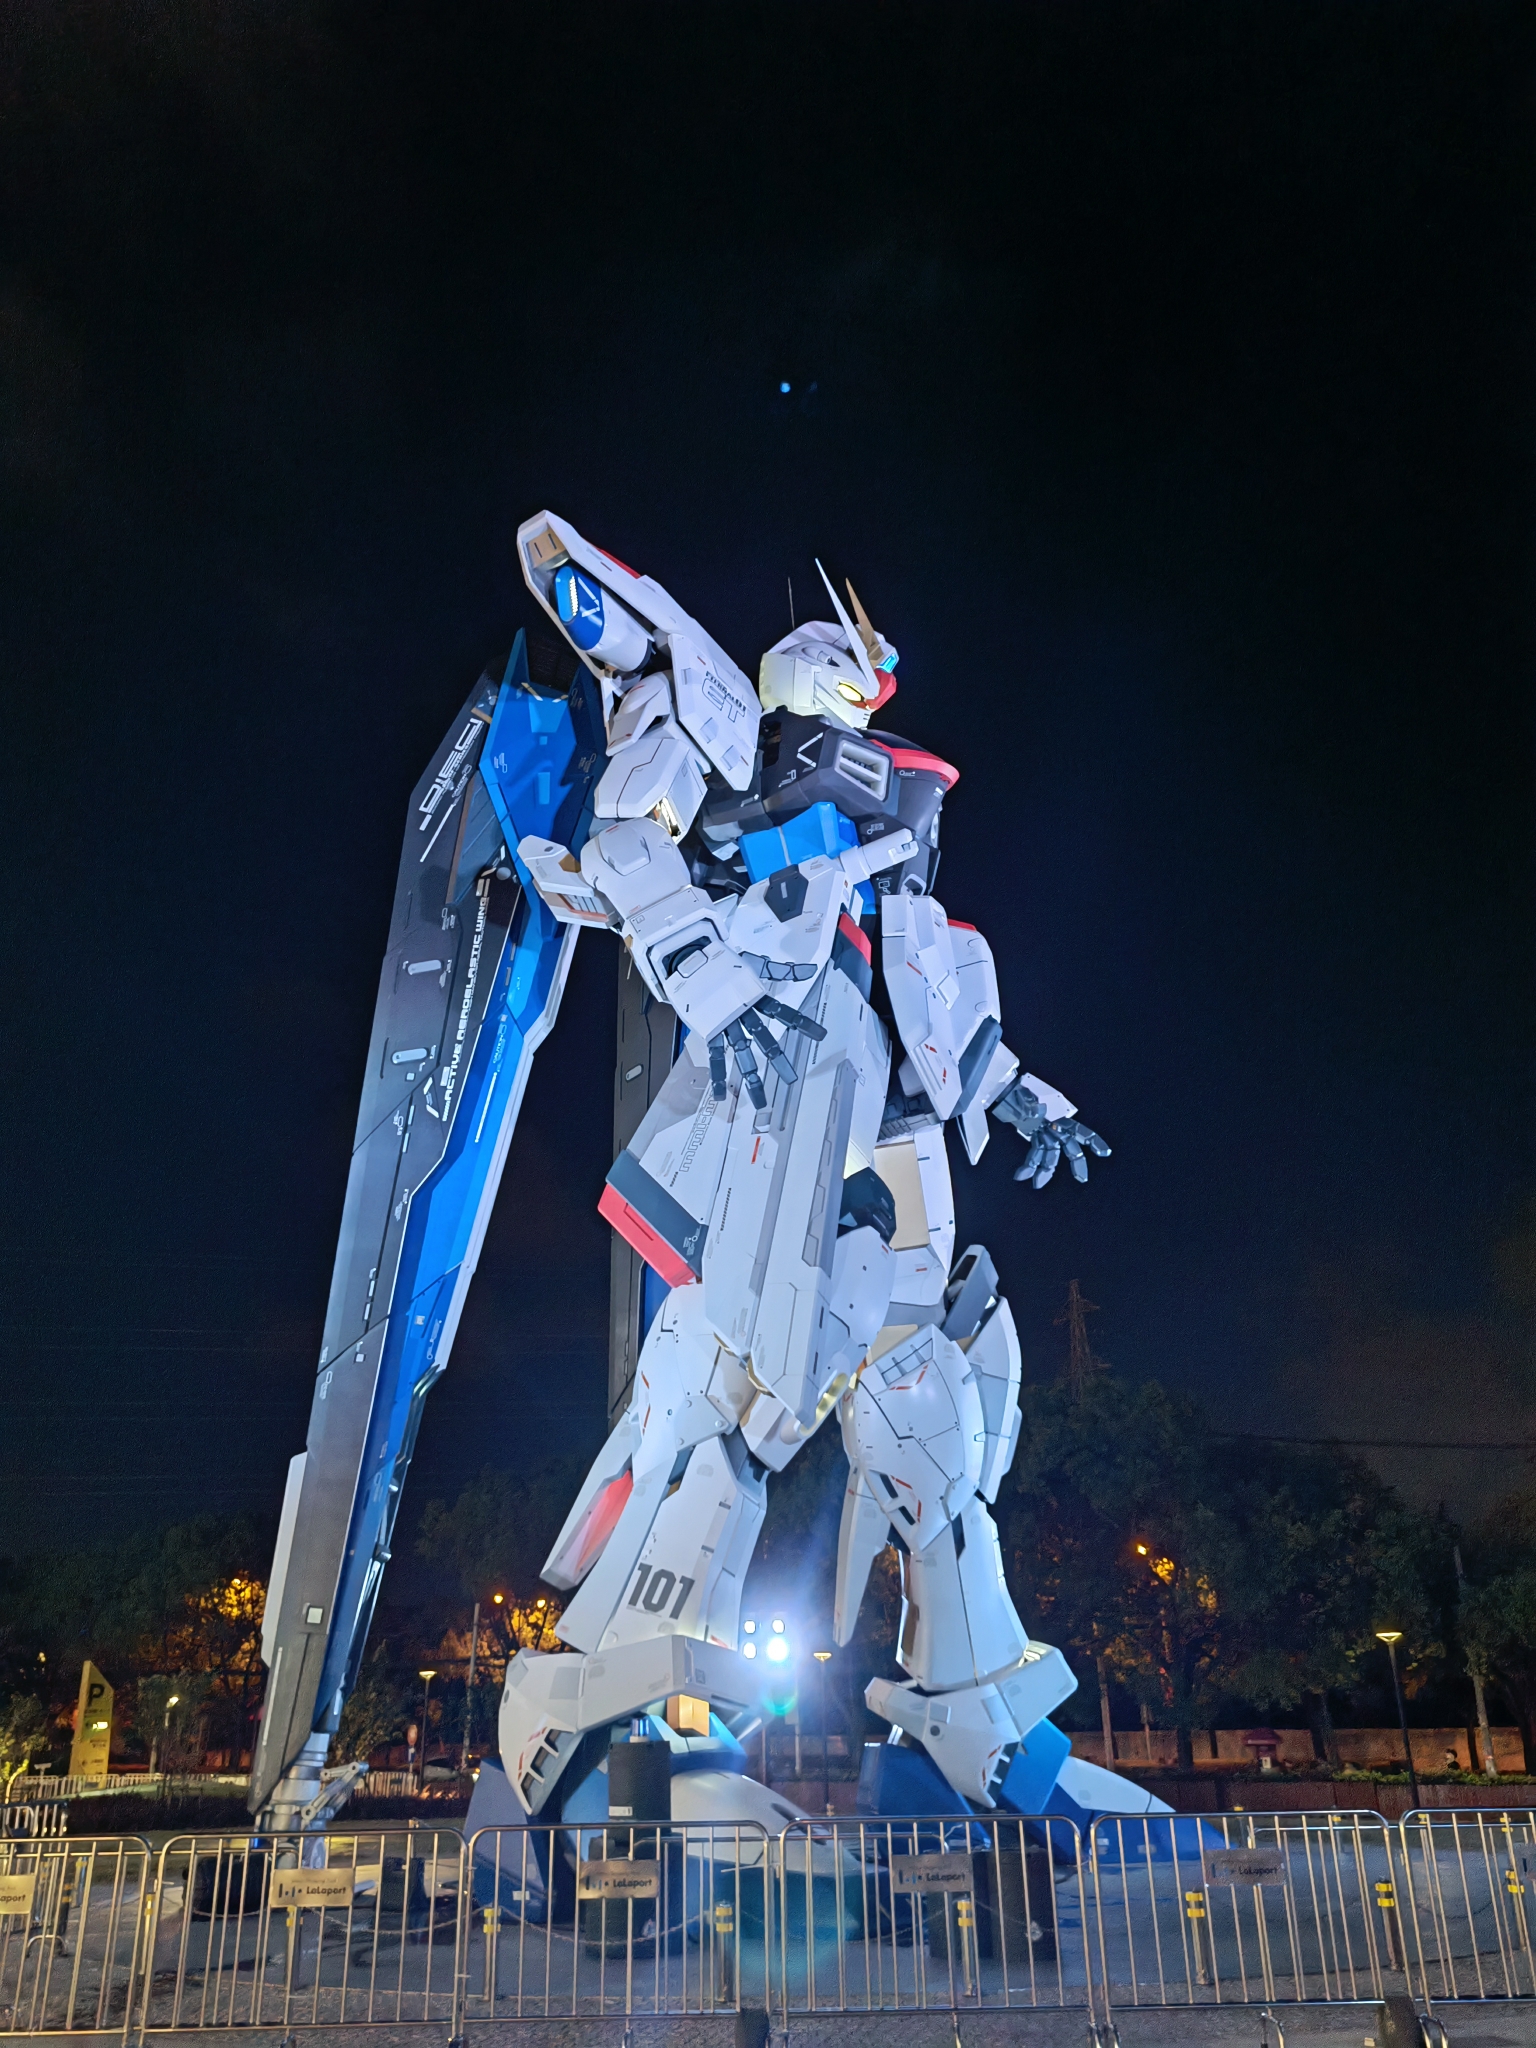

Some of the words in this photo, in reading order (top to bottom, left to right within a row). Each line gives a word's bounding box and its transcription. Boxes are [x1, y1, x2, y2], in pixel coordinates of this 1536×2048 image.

[444, 1043, 463, 1101] ACTIVE
[475, 897, 489, 930] WING
[628, 1562, 696, 1620] 101
[88, 1683, 105, 1707] P
[1239, 1866, 1278, 1877] LaLaport
[306, 1886, 346, 1896] LaLaport
[613, 1878, 652, 1889] LaLaport
